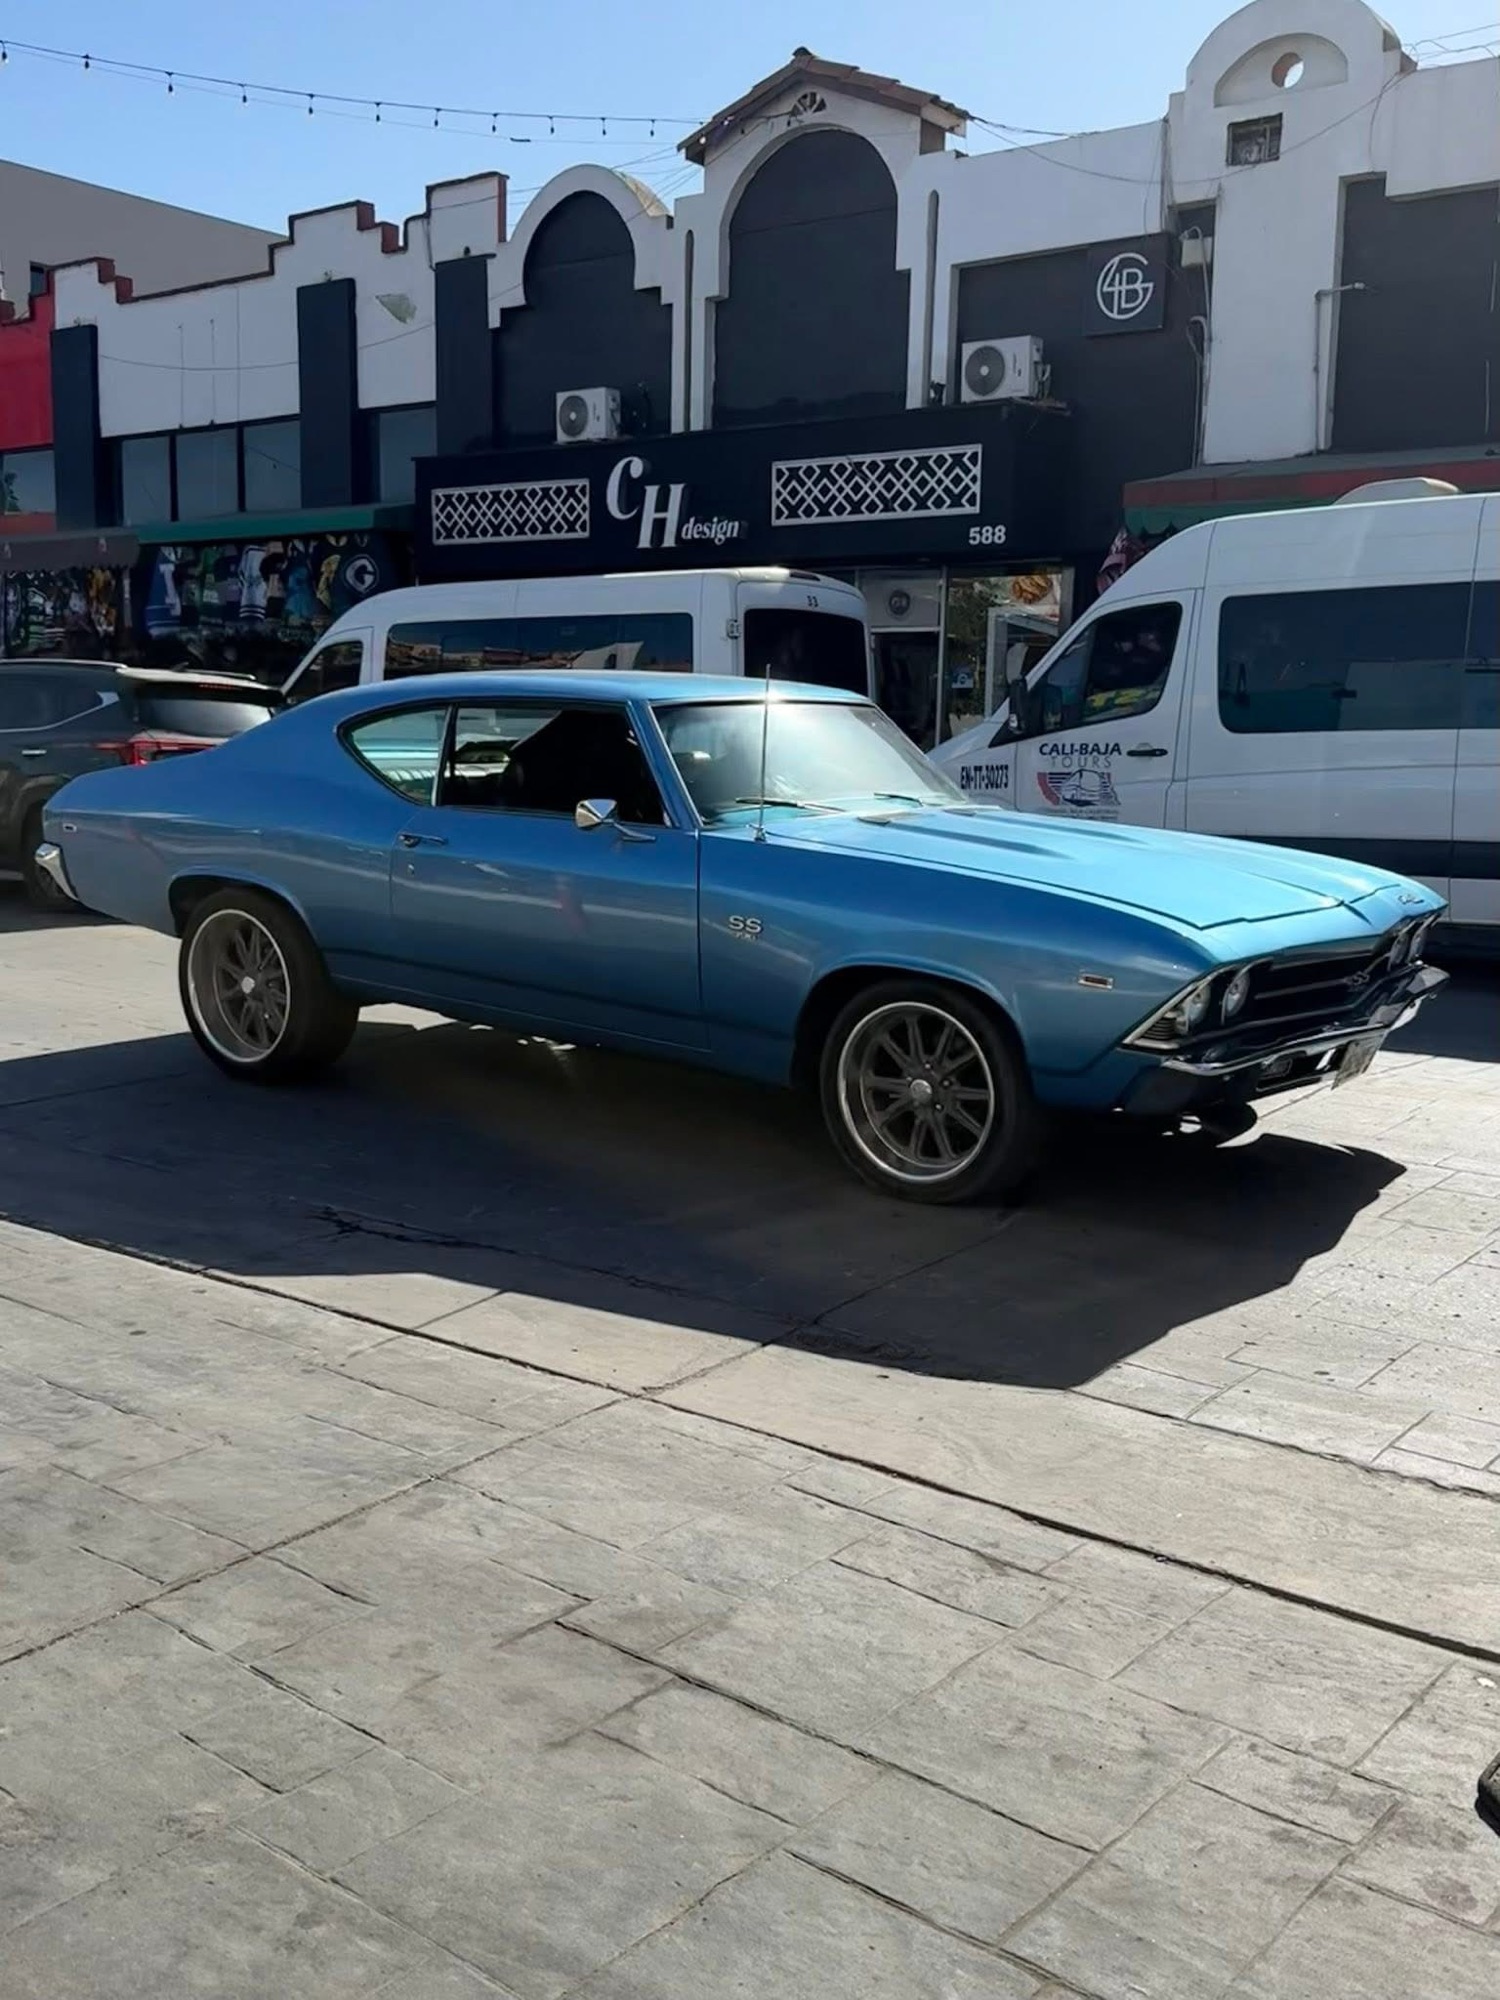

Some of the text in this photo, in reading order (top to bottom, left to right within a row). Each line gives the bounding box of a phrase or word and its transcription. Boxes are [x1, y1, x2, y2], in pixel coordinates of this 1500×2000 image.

[681, 516, 740, 545] design
[968, 525, 1006, 545] 588
[1039, 742, 1122, 756] CALI-BAJA
[1051, 756, 1112, 768] TOURS
[728, 915, 762, 934] SS
